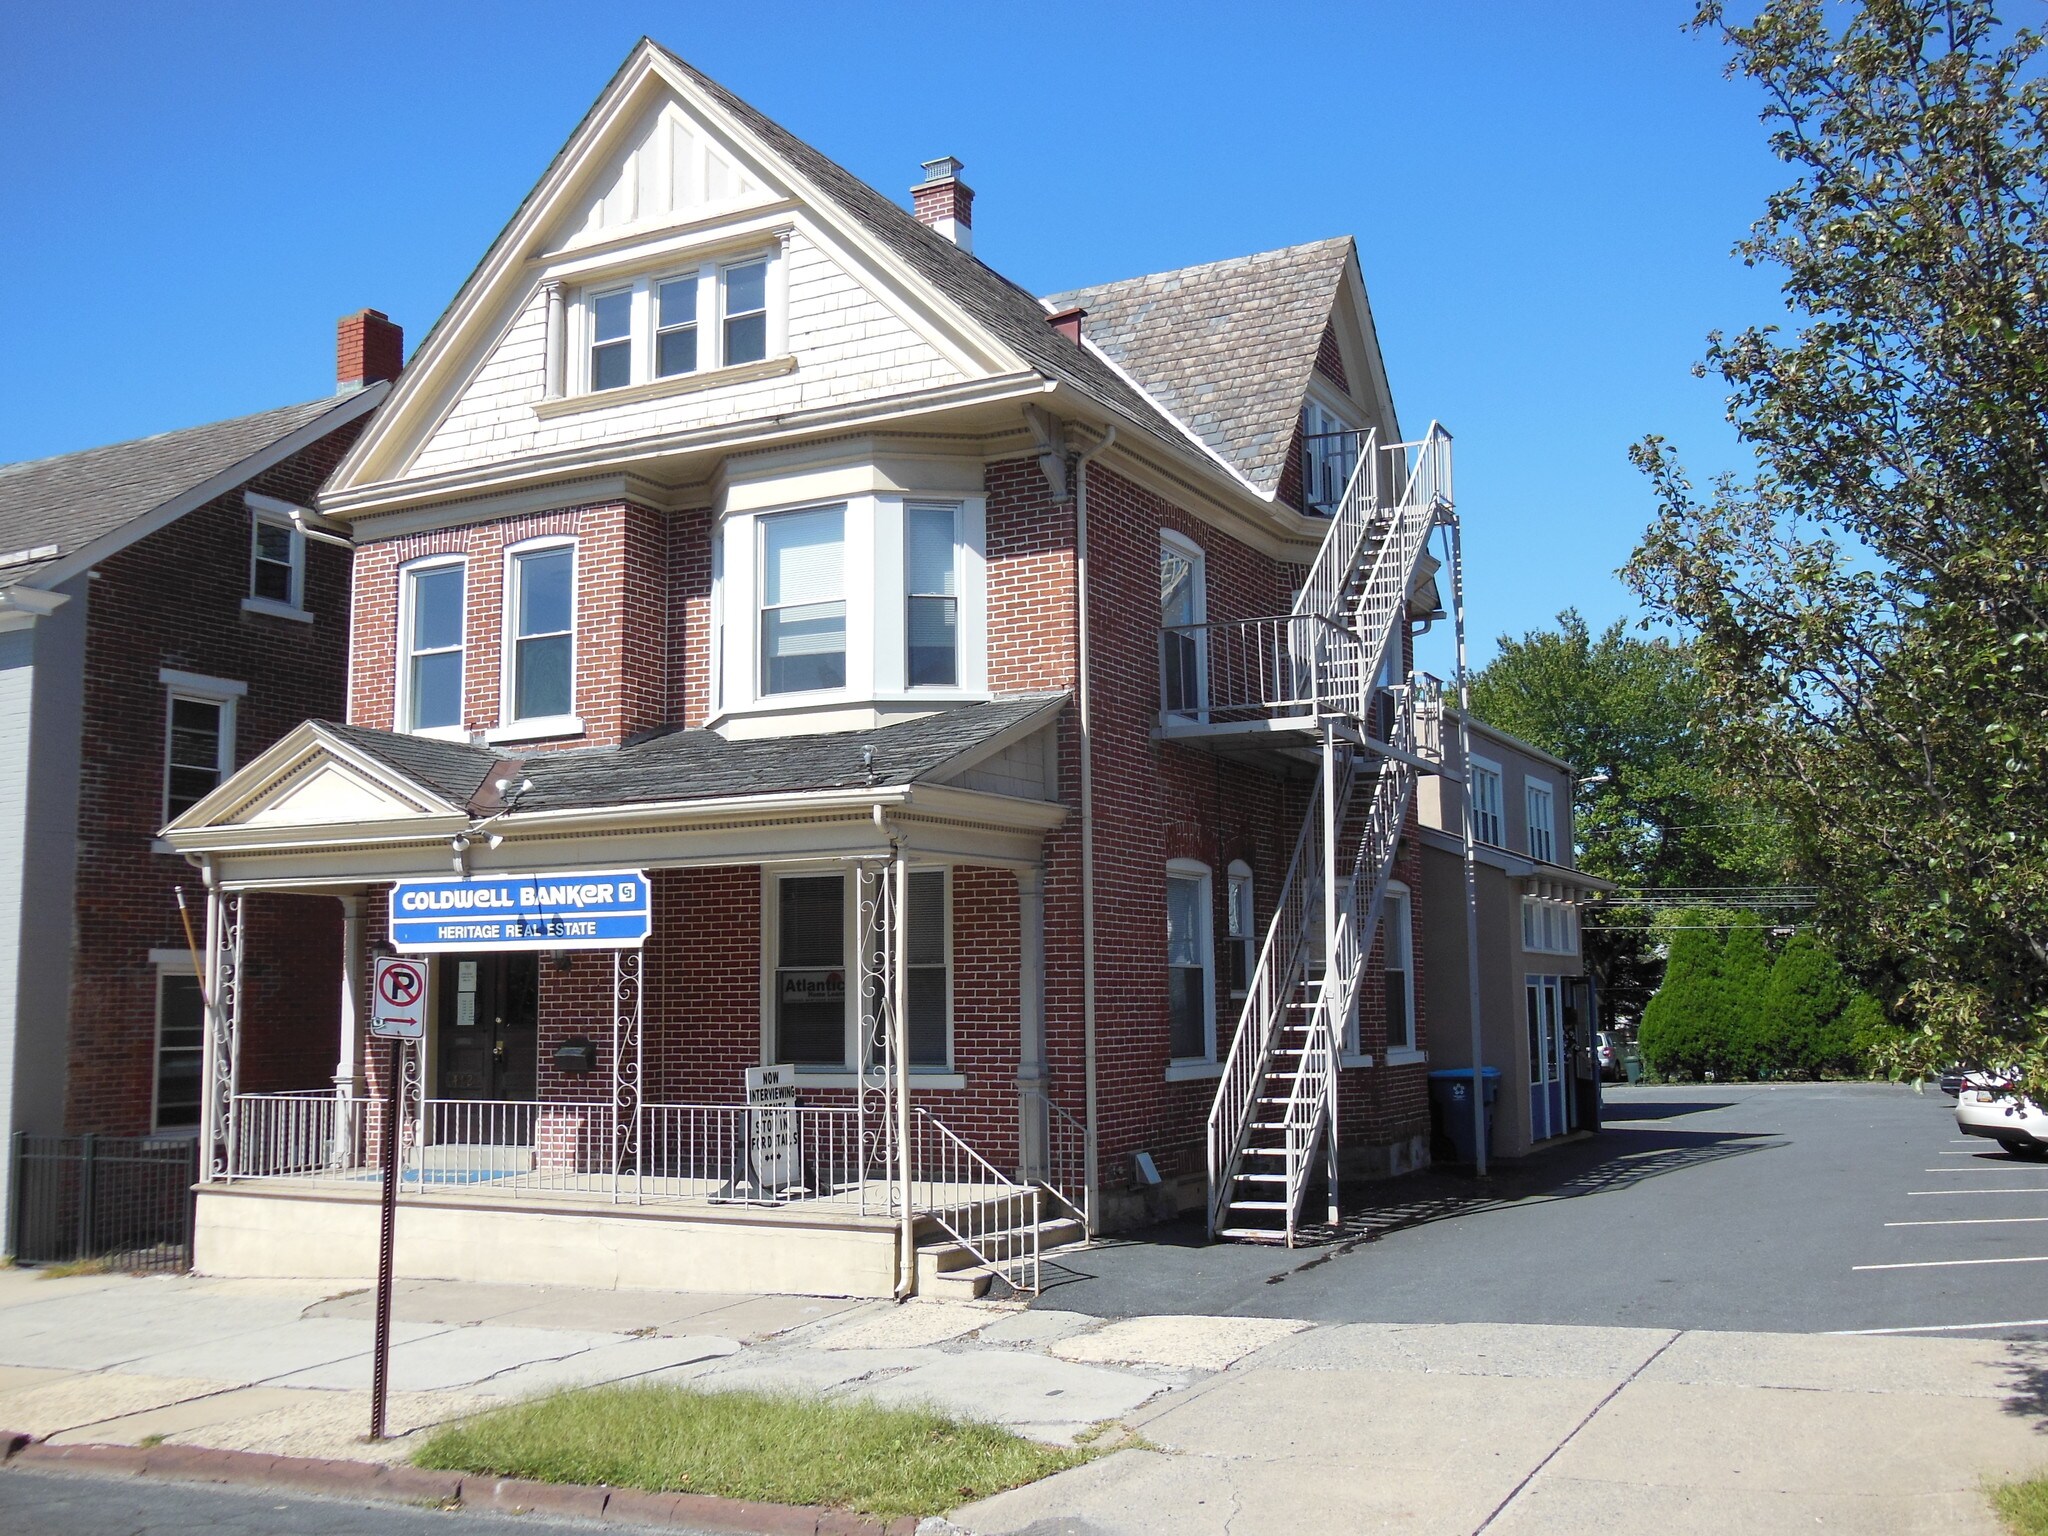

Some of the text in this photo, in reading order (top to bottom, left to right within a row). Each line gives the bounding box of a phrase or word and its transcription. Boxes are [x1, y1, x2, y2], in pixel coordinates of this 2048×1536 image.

[438, 921, 597, 939] HERITAGE REAL ESTATE
[785, 978, 845, 993] Atlantic
[762, 1071, 779, 1086] NOW
[749, 1085, 795, 1103] INTERVIEWING
